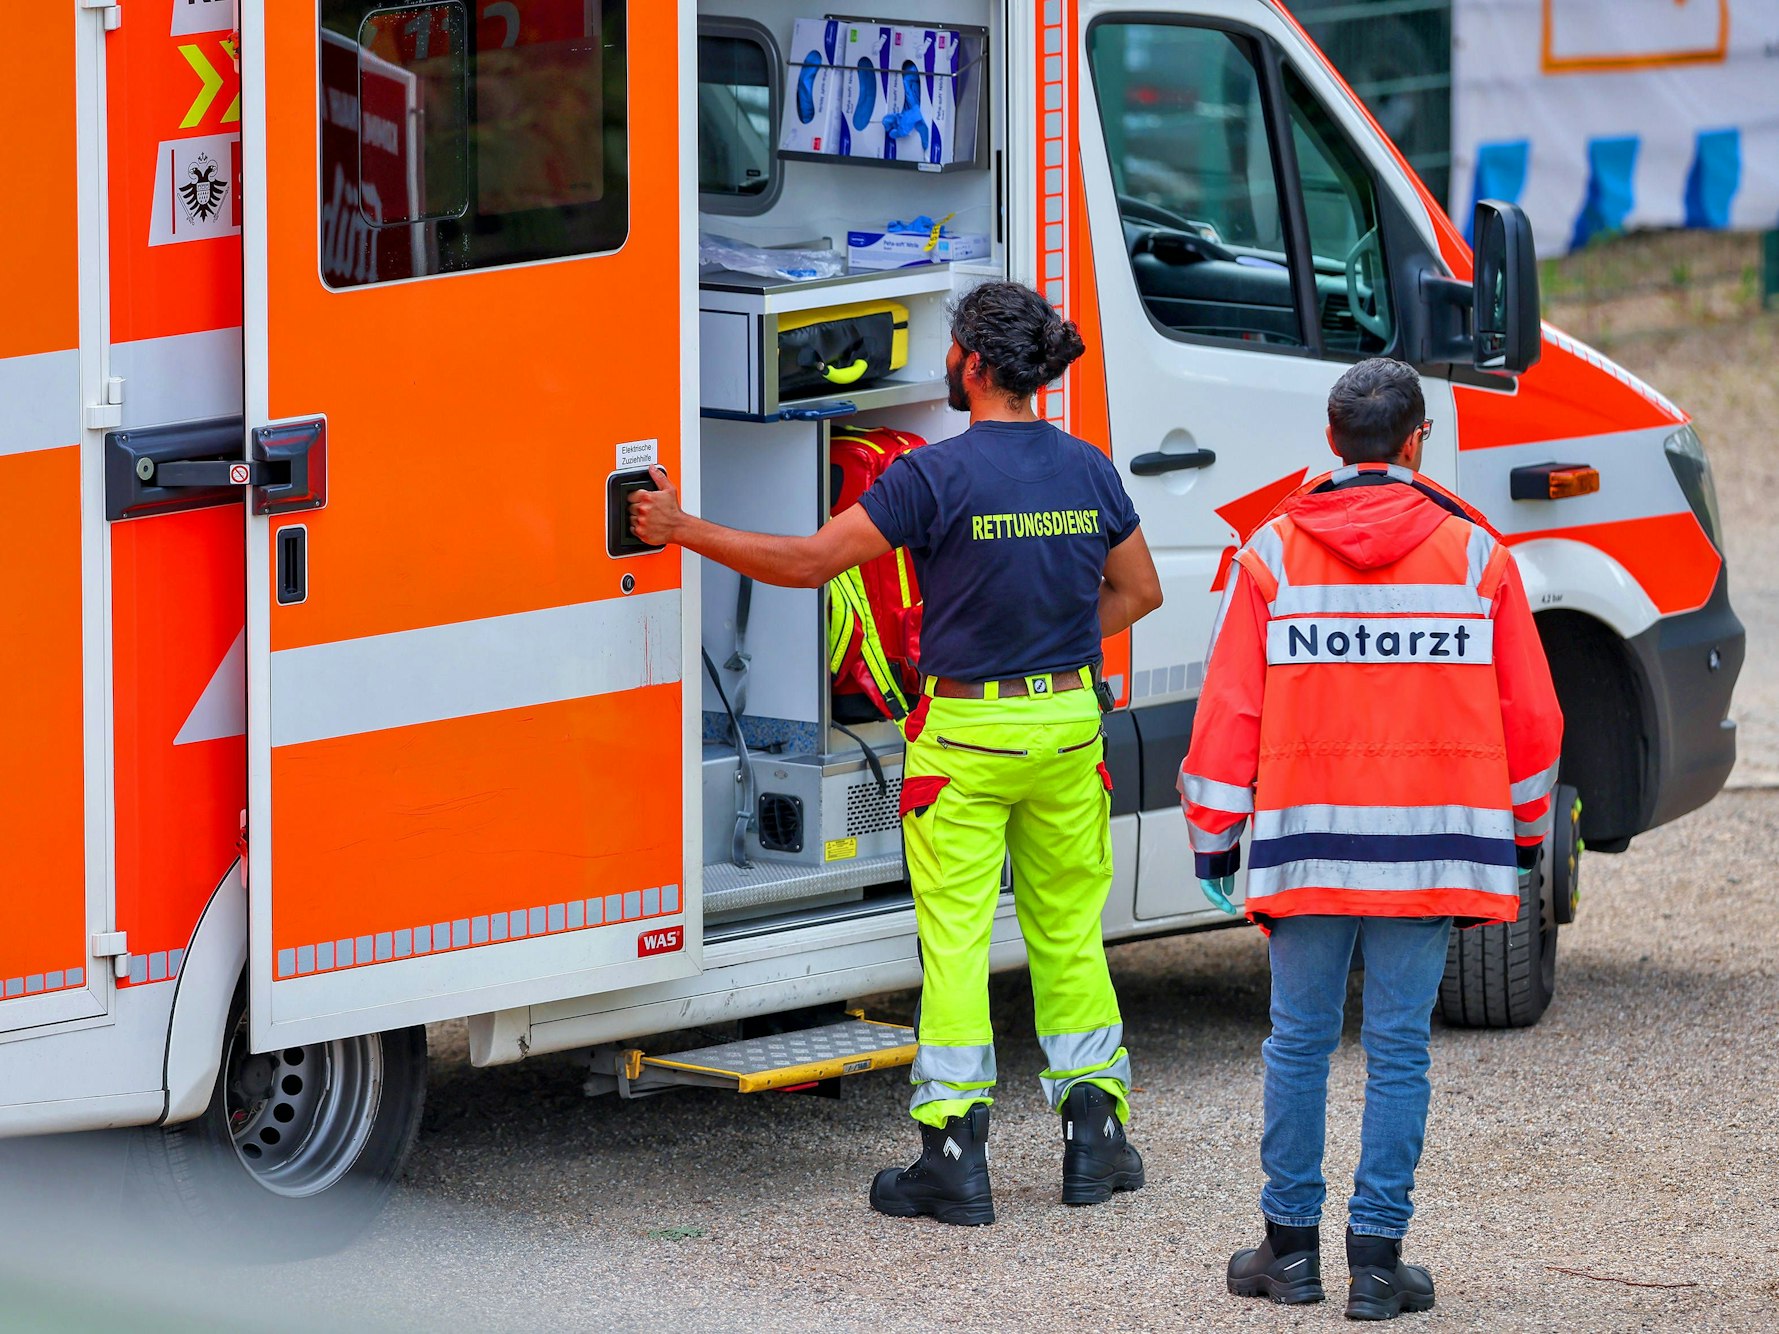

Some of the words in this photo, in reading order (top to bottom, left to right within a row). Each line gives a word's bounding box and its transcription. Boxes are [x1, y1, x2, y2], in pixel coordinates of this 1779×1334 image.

[621, 444, 652, 454] Elektrische
[972, 510, 1099, 540] RETTUNGSDIENST
[1288, 624, 1470, 657] Notarzt
[643, 931, 677, 950] WAS
